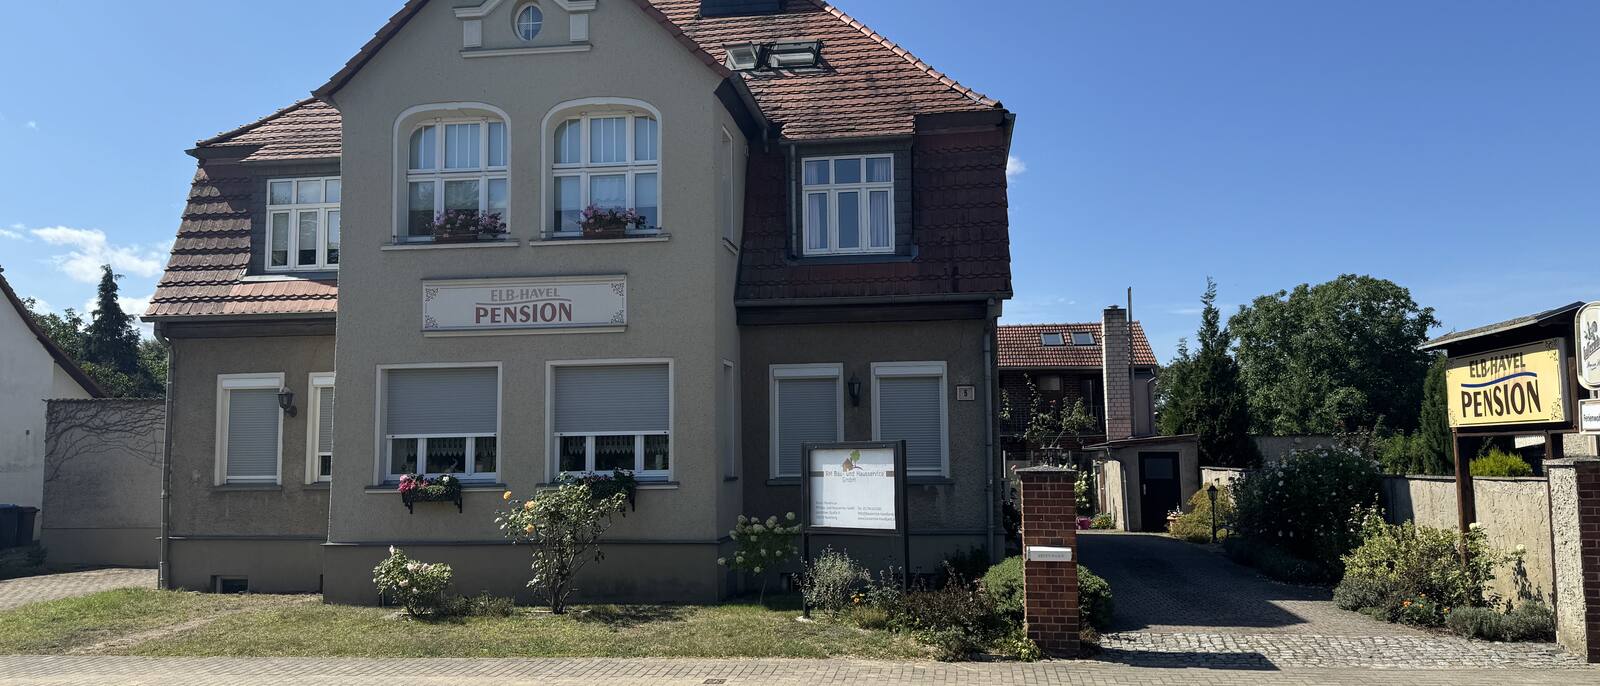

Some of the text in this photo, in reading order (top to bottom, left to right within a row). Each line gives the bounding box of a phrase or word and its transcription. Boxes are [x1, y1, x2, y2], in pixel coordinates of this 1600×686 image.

[490, 288, 560, 302] ELB-HAVEL
[475, 302, 572, 324] PENSION
[1469, 352, 1526, 378] ELB-HAVEL
[1460, 379, 1541, 418] PENSION
